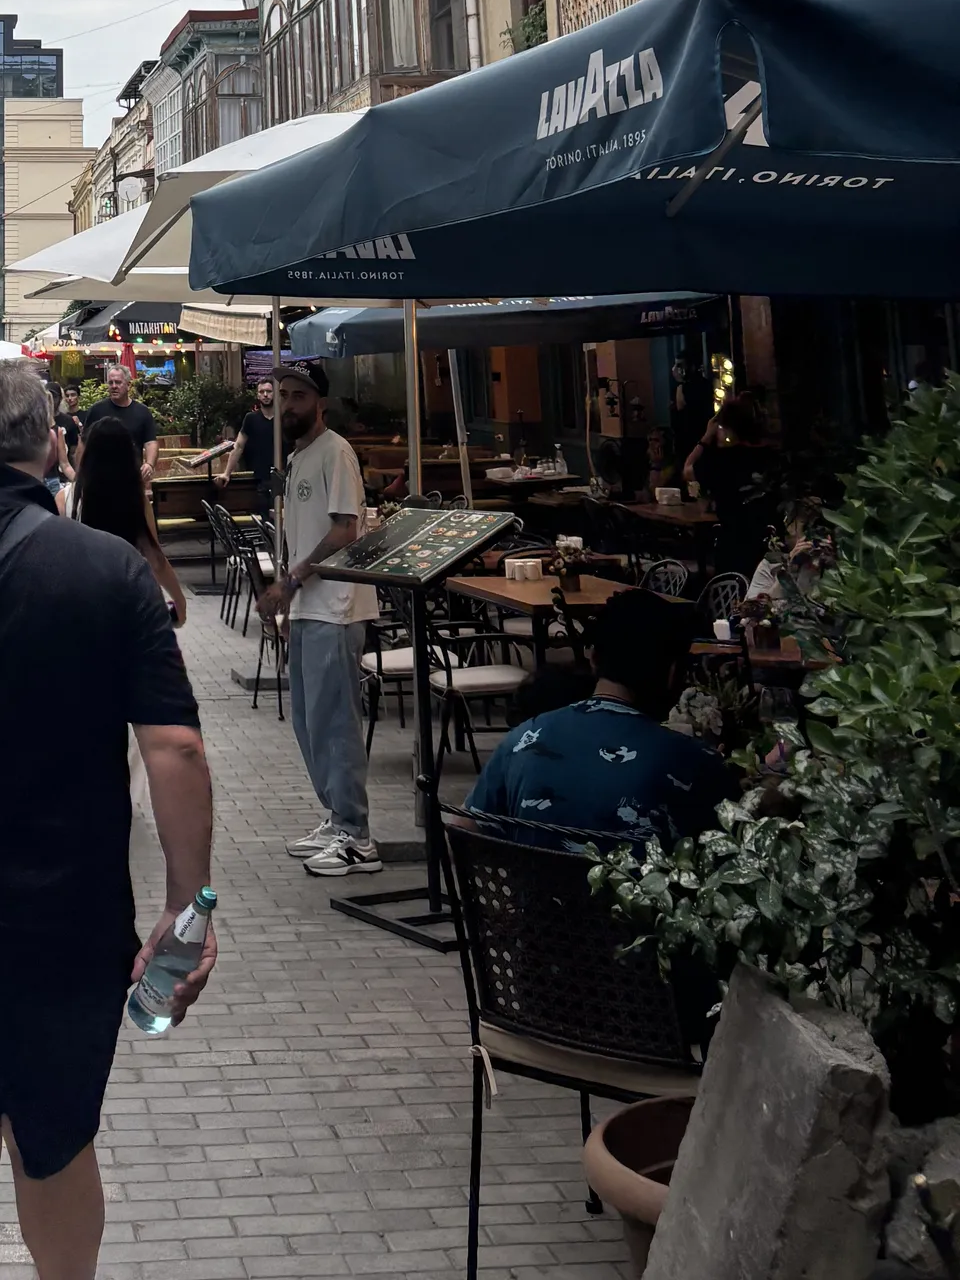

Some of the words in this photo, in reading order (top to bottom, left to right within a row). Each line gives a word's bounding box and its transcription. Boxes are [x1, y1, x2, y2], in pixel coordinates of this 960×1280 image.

[536, 47, 663, 140] LAVAZZA
[622, 129, 646, 148] 1895
[128, 322, 178, 335] NATAKHTARI
